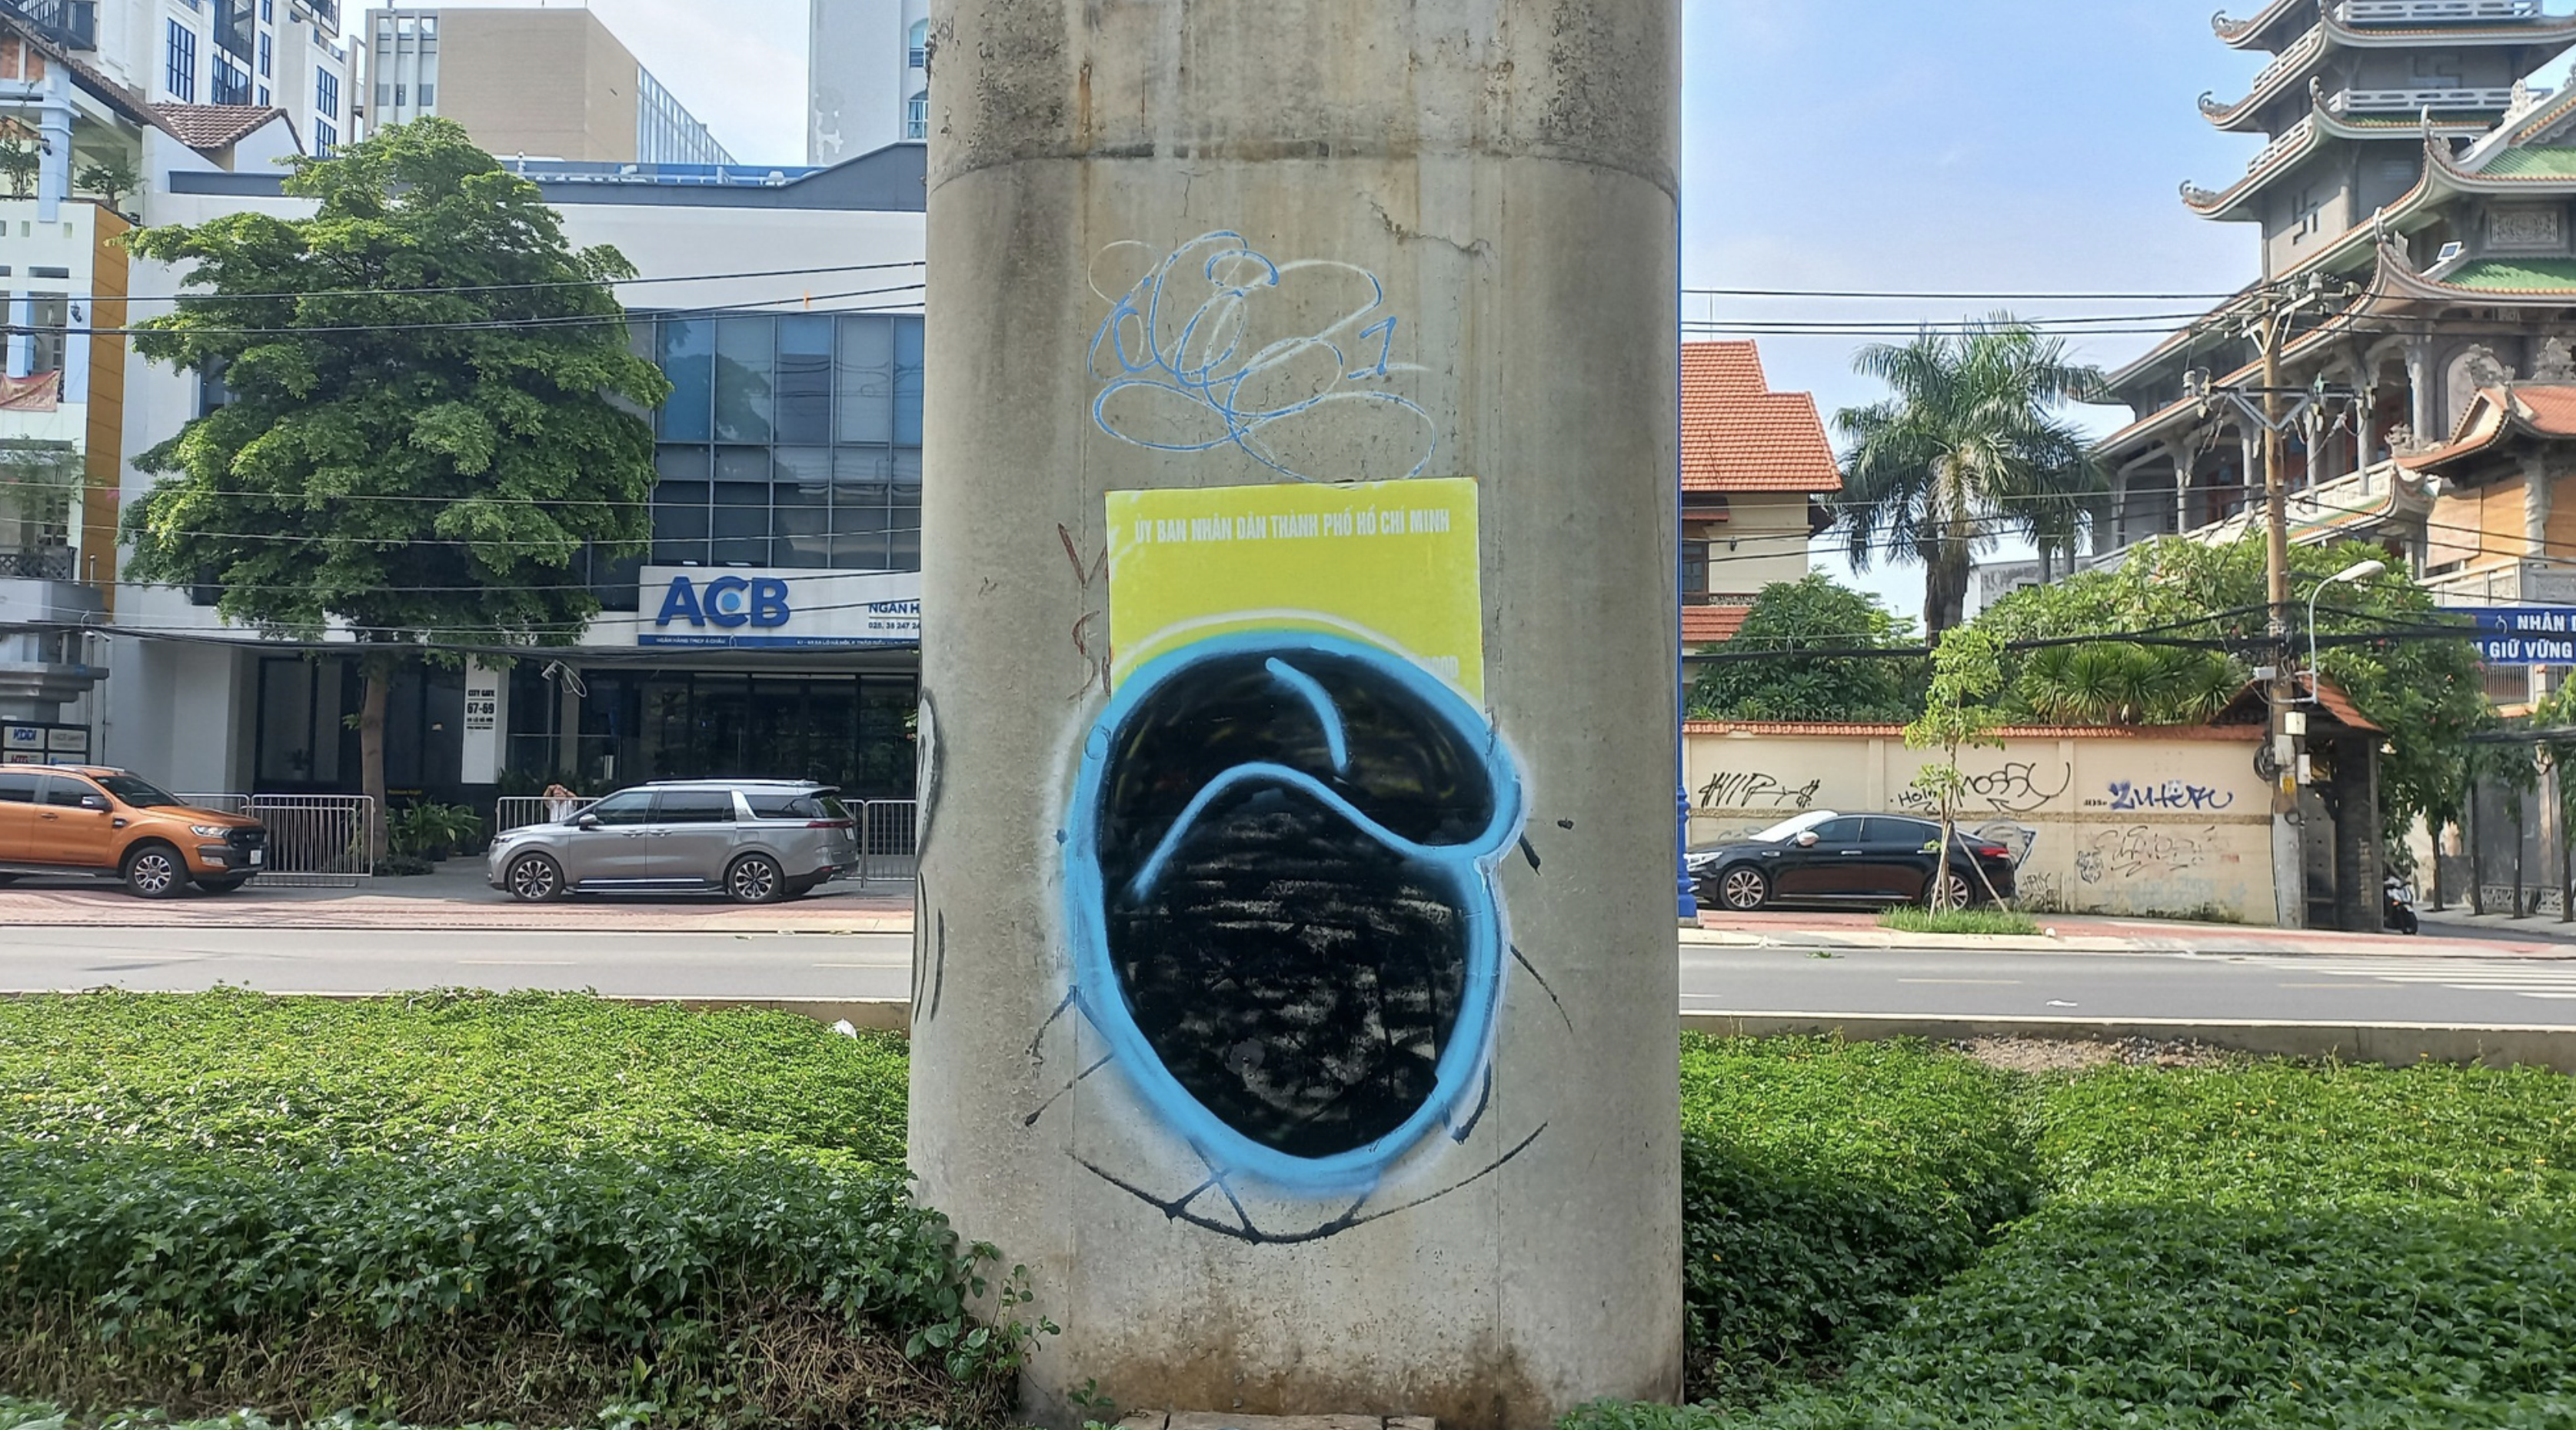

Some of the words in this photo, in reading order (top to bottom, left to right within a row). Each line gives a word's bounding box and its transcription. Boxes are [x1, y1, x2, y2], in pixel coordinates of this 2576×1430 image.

[1157, 519, 1186, 542] BAN
[1192, 512, 1232, 540] NHÂN
[1236, 511, 1266, 540] DÂN
[1270, 509, 1318, 538] THÀNH
[1323, 504, 1353, 536] PHỐ
[1381, 504, 1405, 534] CHÍ
[1410, 508, 1449, 533] MINH
[656, 576, 790, 627] ACB
[2517, 610, 2565, 631] NHÂN
[2489, 638, 2521, 659] GIỮ
[2524, 638, 2573, 659] VỮNG
[468, 702, 494, 713] 67-69
